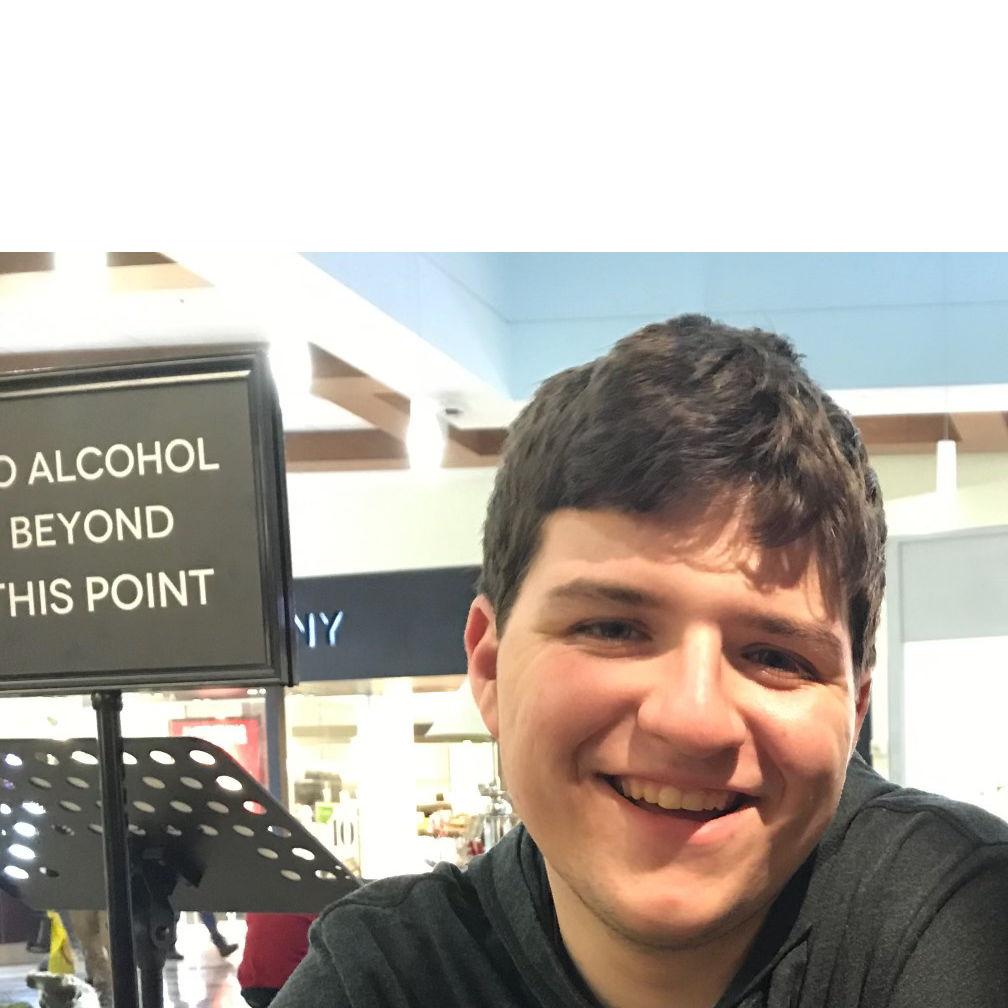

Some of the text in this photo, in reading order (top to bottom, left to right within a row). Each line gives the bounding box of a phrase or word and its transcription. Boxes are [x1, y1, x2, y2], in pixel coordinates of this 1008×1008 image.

[28, 437, 220, 485] ALCOHOL
[10, 505, 174, 549] BEYOND
[0, 568, 215, 617] HIS POINT
